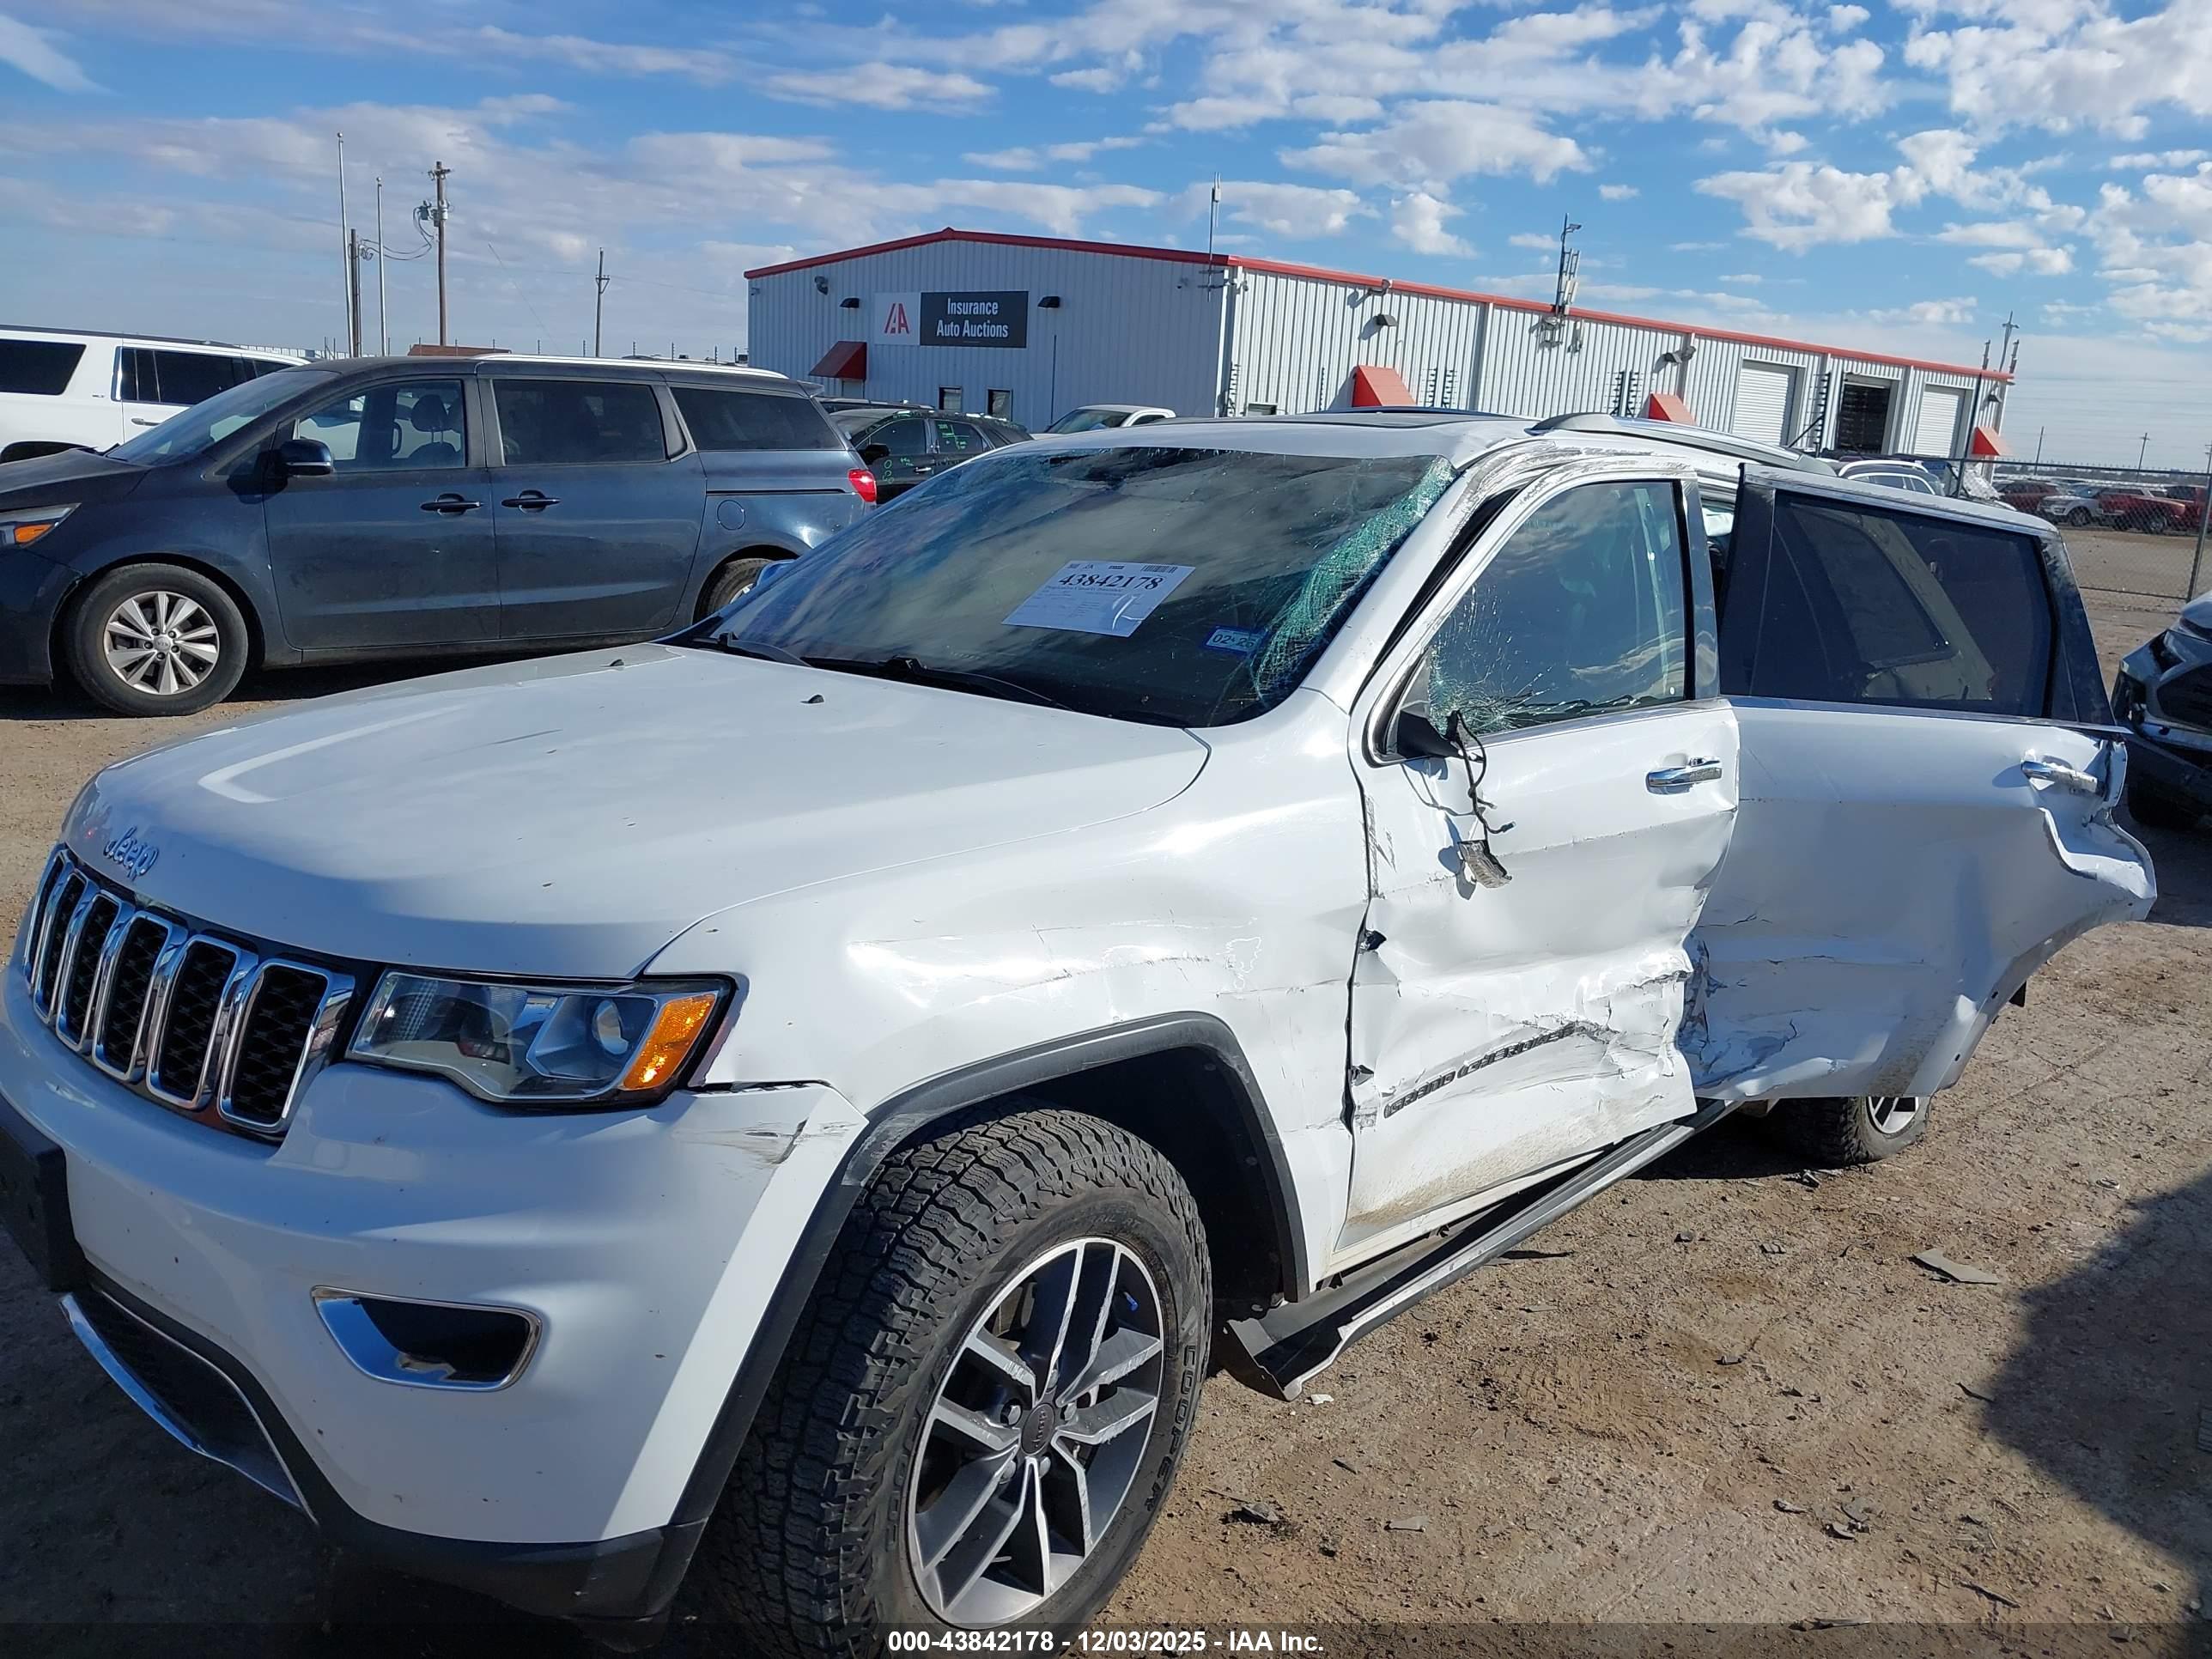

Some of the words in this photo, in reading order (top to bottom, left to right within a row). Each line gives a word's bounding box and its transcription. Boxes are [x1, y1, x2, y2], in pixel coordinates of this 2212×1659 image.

[947, 297, 999, 315] Insurance
[936, 319, 960, 337] Auto
[962, 319, 1009, 337] Auctions
[1059, 573, 1164, 590] 43842178
[103, 826, 157, 881] Jeep
[1384, 1071, 1455, 1119] GRAND
[1144, 1345, 1196, 1512] COOPER
